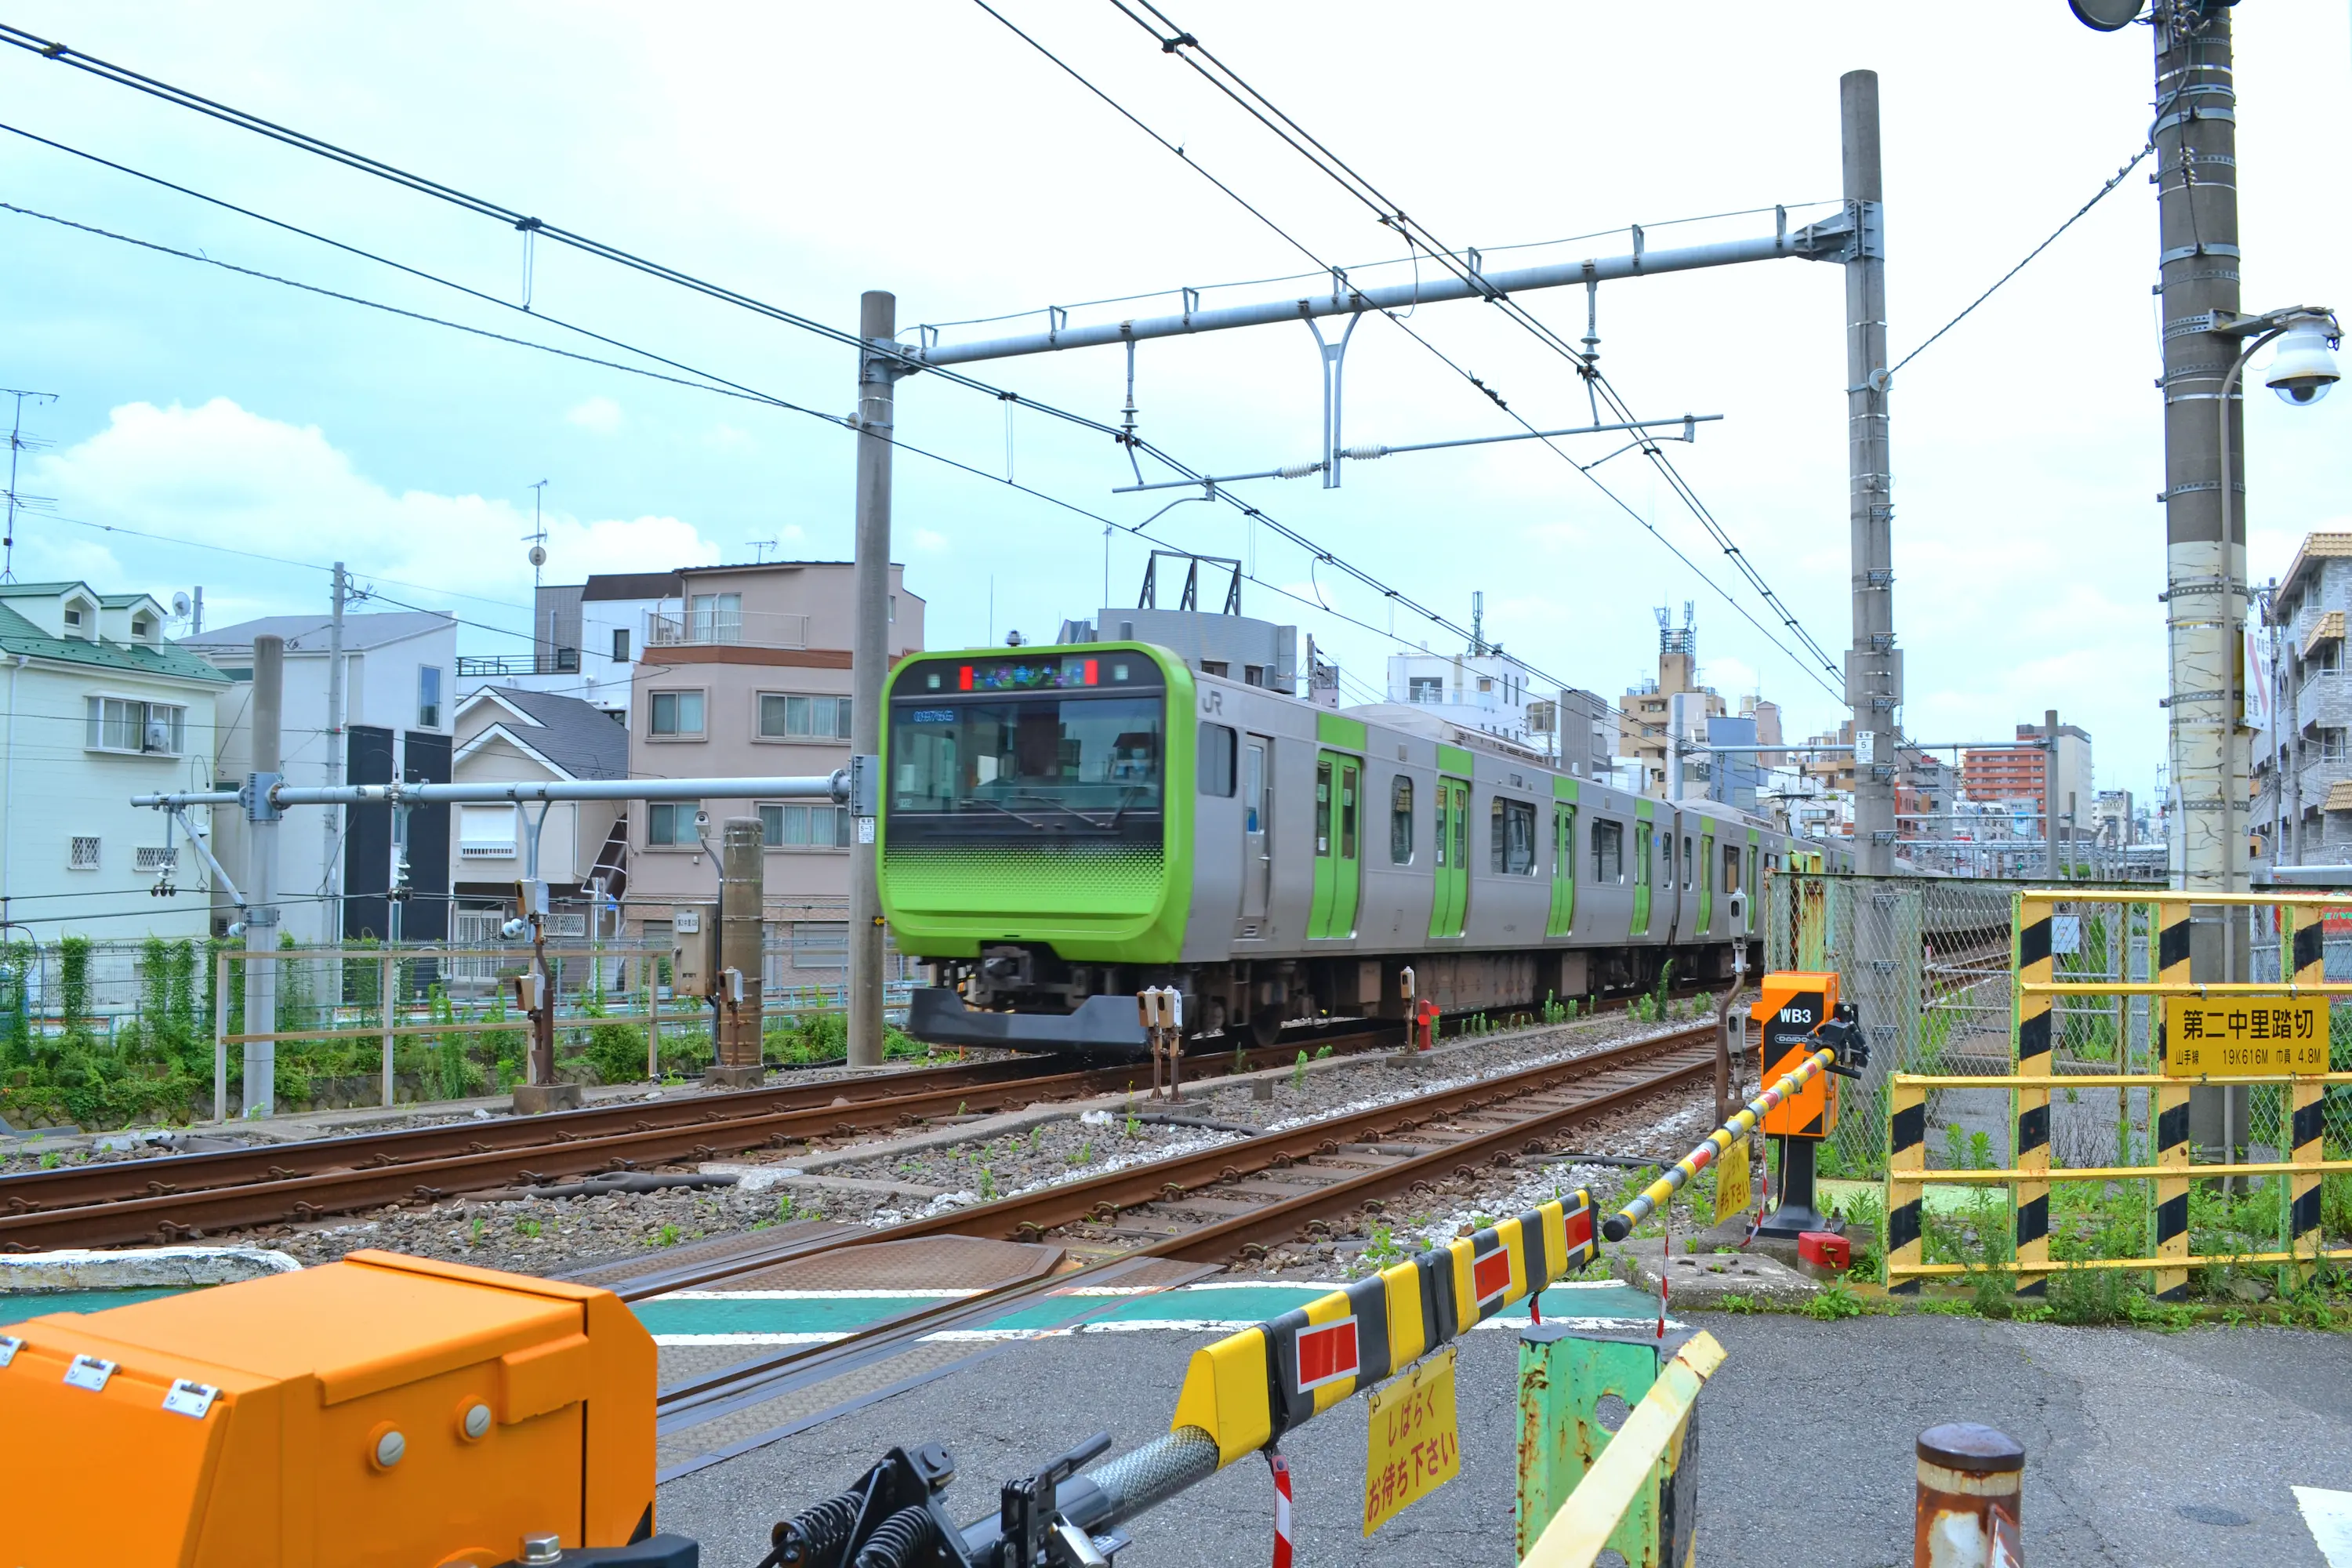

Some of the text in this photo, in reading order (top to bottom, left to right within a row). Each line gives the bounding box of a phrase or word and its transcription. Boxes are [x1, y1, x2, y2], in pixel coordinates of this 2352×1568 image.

[1202, 691, 1222, 716] JR
[1780, 1008, 1812, 1024] WB3
[2183, 1009, 2314, 1040] 第二中里踏切
[2176, 1049, 2200, 1065] 山手線
[2223, 1048, 2269, 1065] 19K616M
[2298, 1047, 2321, 1065] 4.8M
[1388, 1383, 1435, 1448] しばらく
[1367, 1431, 1456, 1523] お待ち下さい
